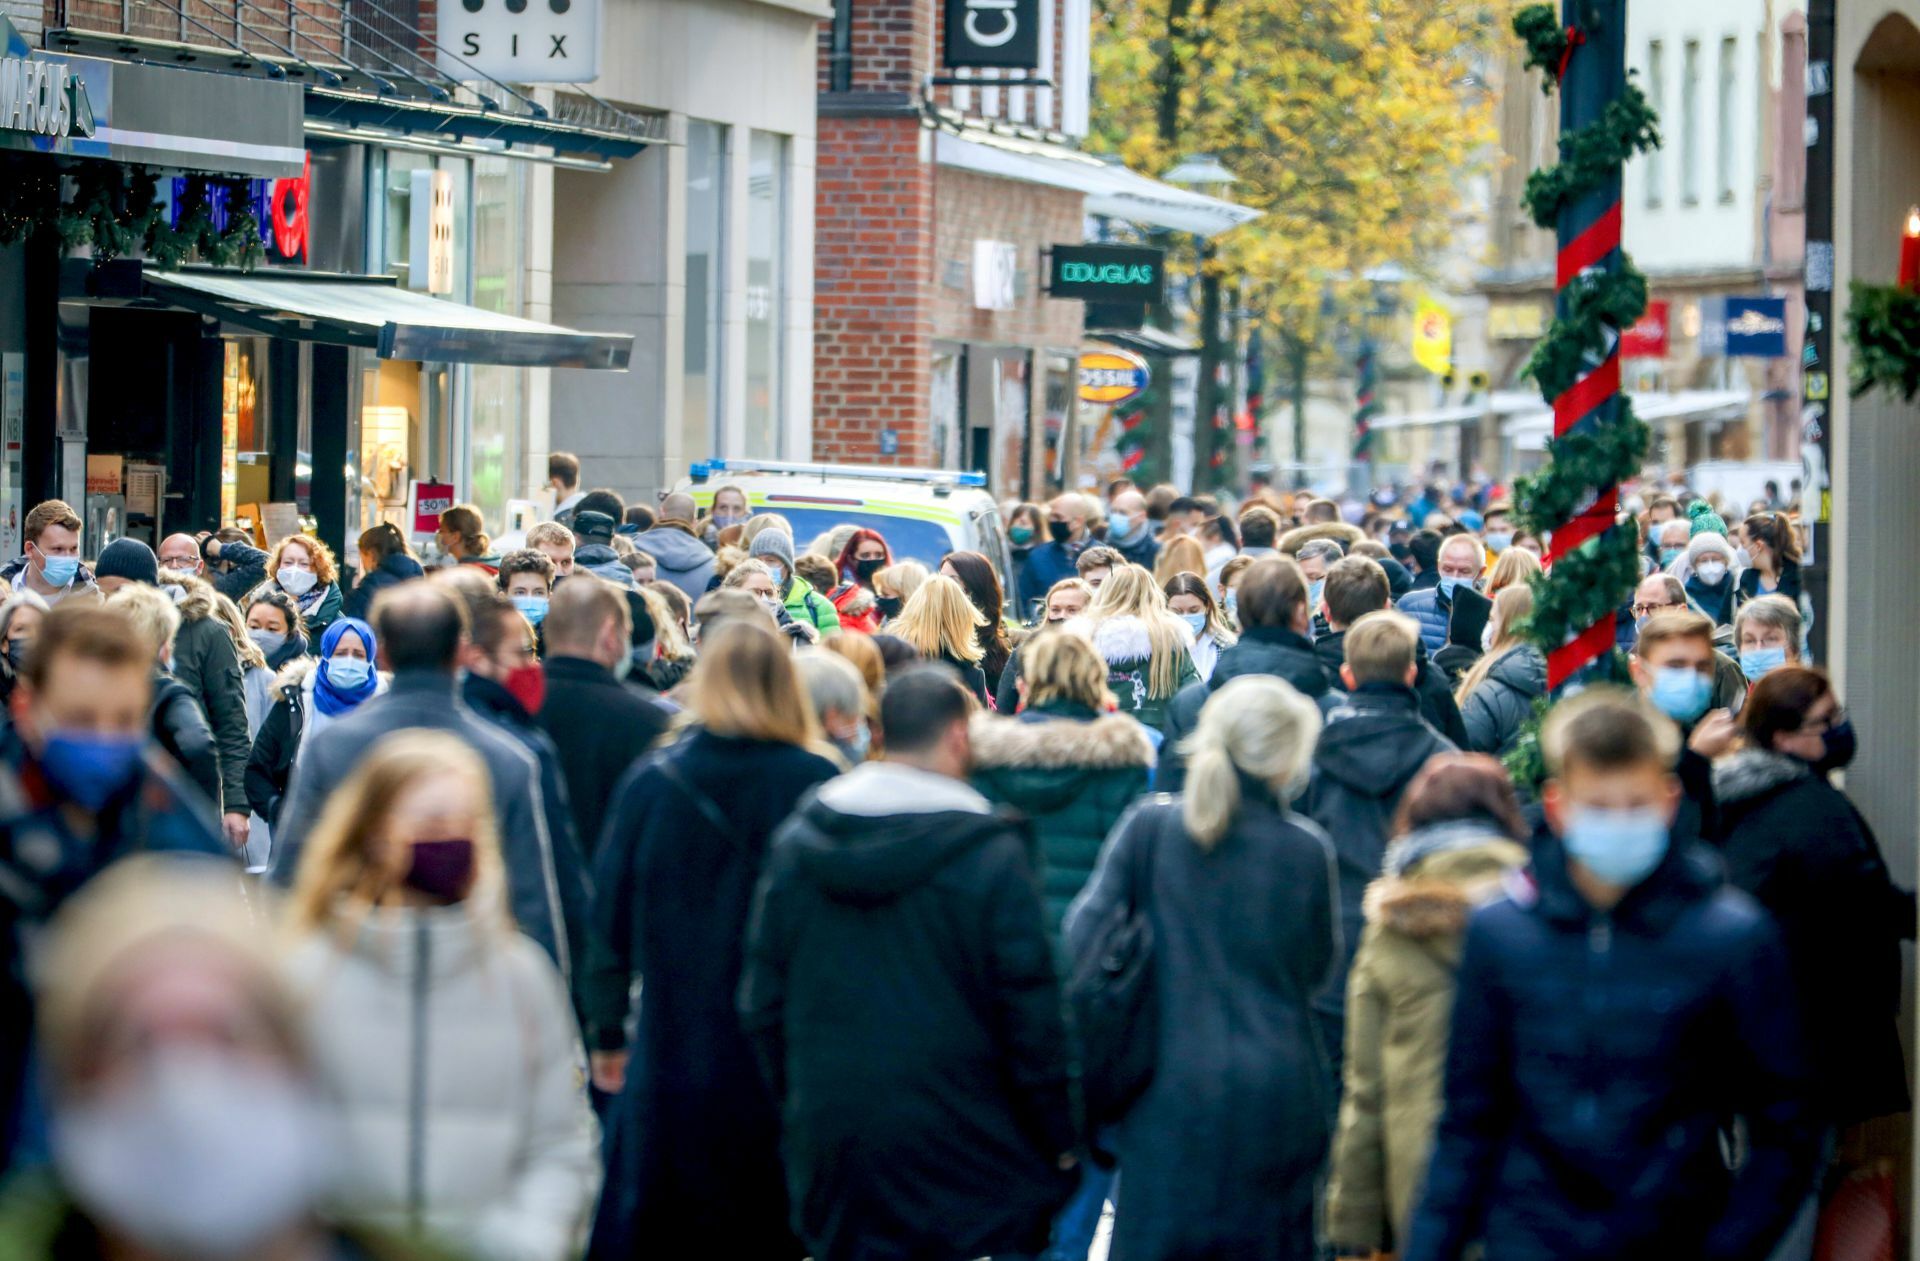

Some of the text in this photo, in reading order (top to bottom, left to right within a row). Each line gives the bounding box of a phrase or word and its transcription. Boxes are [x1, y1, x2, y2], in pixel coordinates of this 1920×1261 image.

[463, 33, 567, 58] SIX
[1061, 262, 1152, 285] DOUGLAS
[1078, 369, 1137, 388] OSSIL
